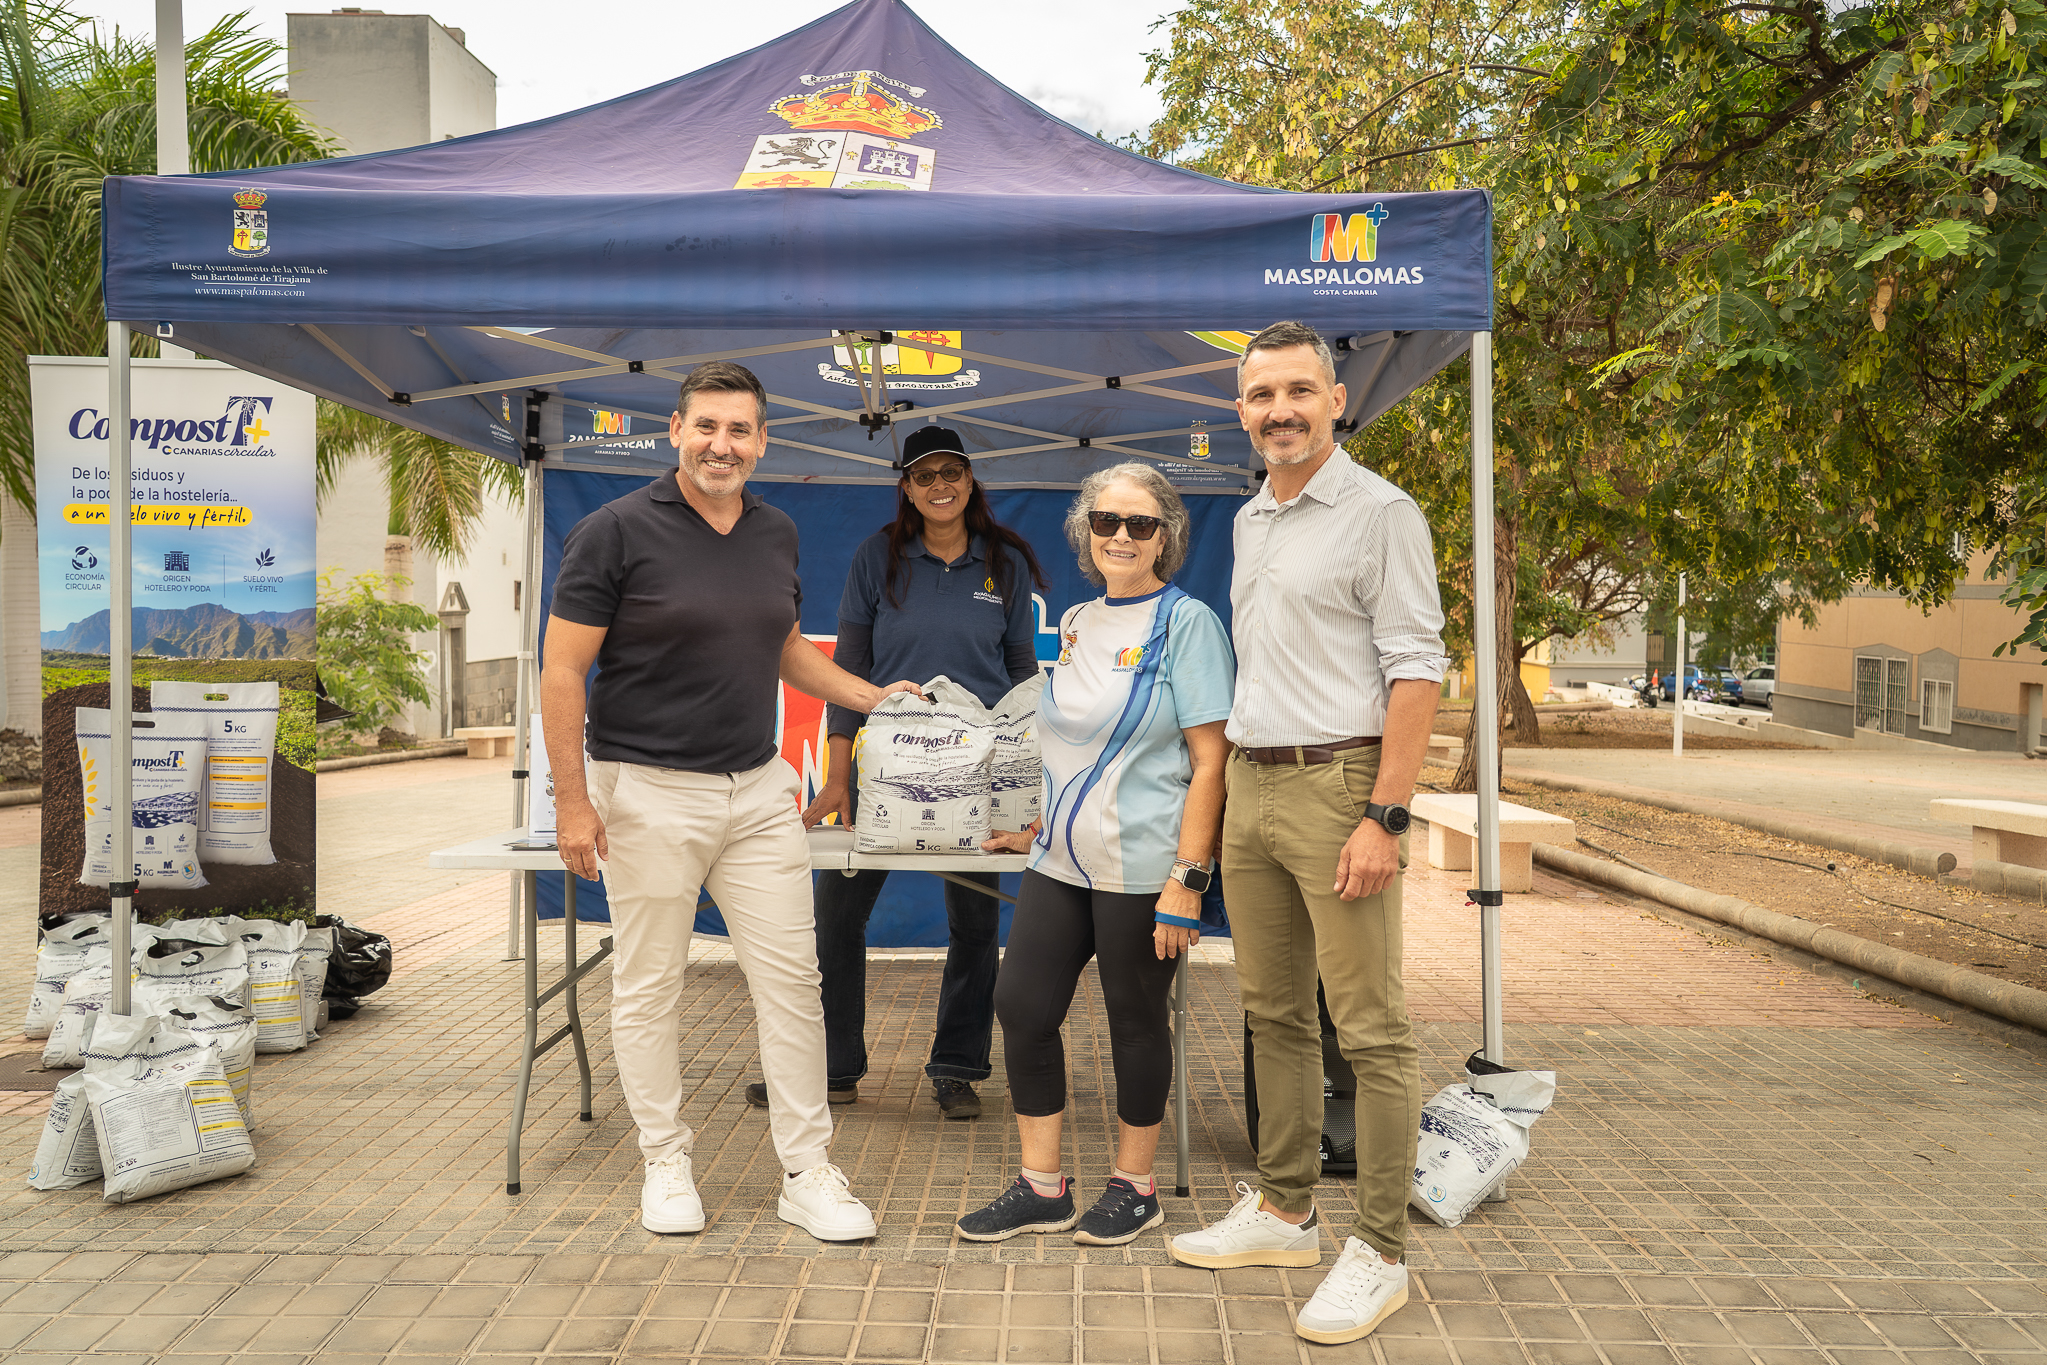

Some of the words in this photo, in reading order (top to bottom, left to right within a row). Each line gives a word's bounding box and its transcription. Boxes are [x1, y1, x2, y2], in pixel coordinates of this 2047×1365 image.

[171, 262, 203, 271] Ilustre
[204, 264, 269, 274] Ayuntamiento
[270, 265, 282, 273] de
[293, 266, 316, 274] Villa
[191, 273, 209, 281] San
[210, 273, 259, 282] Bartolomé
[260, 274, 272, 282] de
[273, 275, 311, 285] Tirajana
[1264, 266, 1424, 285] MASPALOMAS
[195, 286, 306, 298] www.maspalomas.com
[72, 467, 91, 480] De
[131, 468, 174, 482] siduos
[177, 471, 185, 484] y
[72, 486, 84, 499] la
[148, 488, 160, 501] la
[71, 510, 79, 519] a
[86, 510, 105, 519] un
[131, 505, 147, 521] elo
[154, 511, 180, 521] vivo
[188, 512, 195, 530] y
[202, 506, 247, 530] fértil.
[65, 572, 105, 581] ECONOMÍA
[243, 575, 265, 583] SUELO
[266, 575, 284, 583] VIVO
[65, 582, 102, 590] CIRCULAR
[144, 584, 182, 592] HOTELERO
[190, 585, 211, 593] PODA
[249, 585, 255, 593] Y
[255, 583, 278, 593] FÉRTIL
[223, 720, 233, 733] 5
[234, 725, 247, 733] KG
[915, 839, 926, 851] 5
[133, 863, 142, 877] 5
[143, 869, 154, 877] KG
[260, 960, 268, 970] 5
